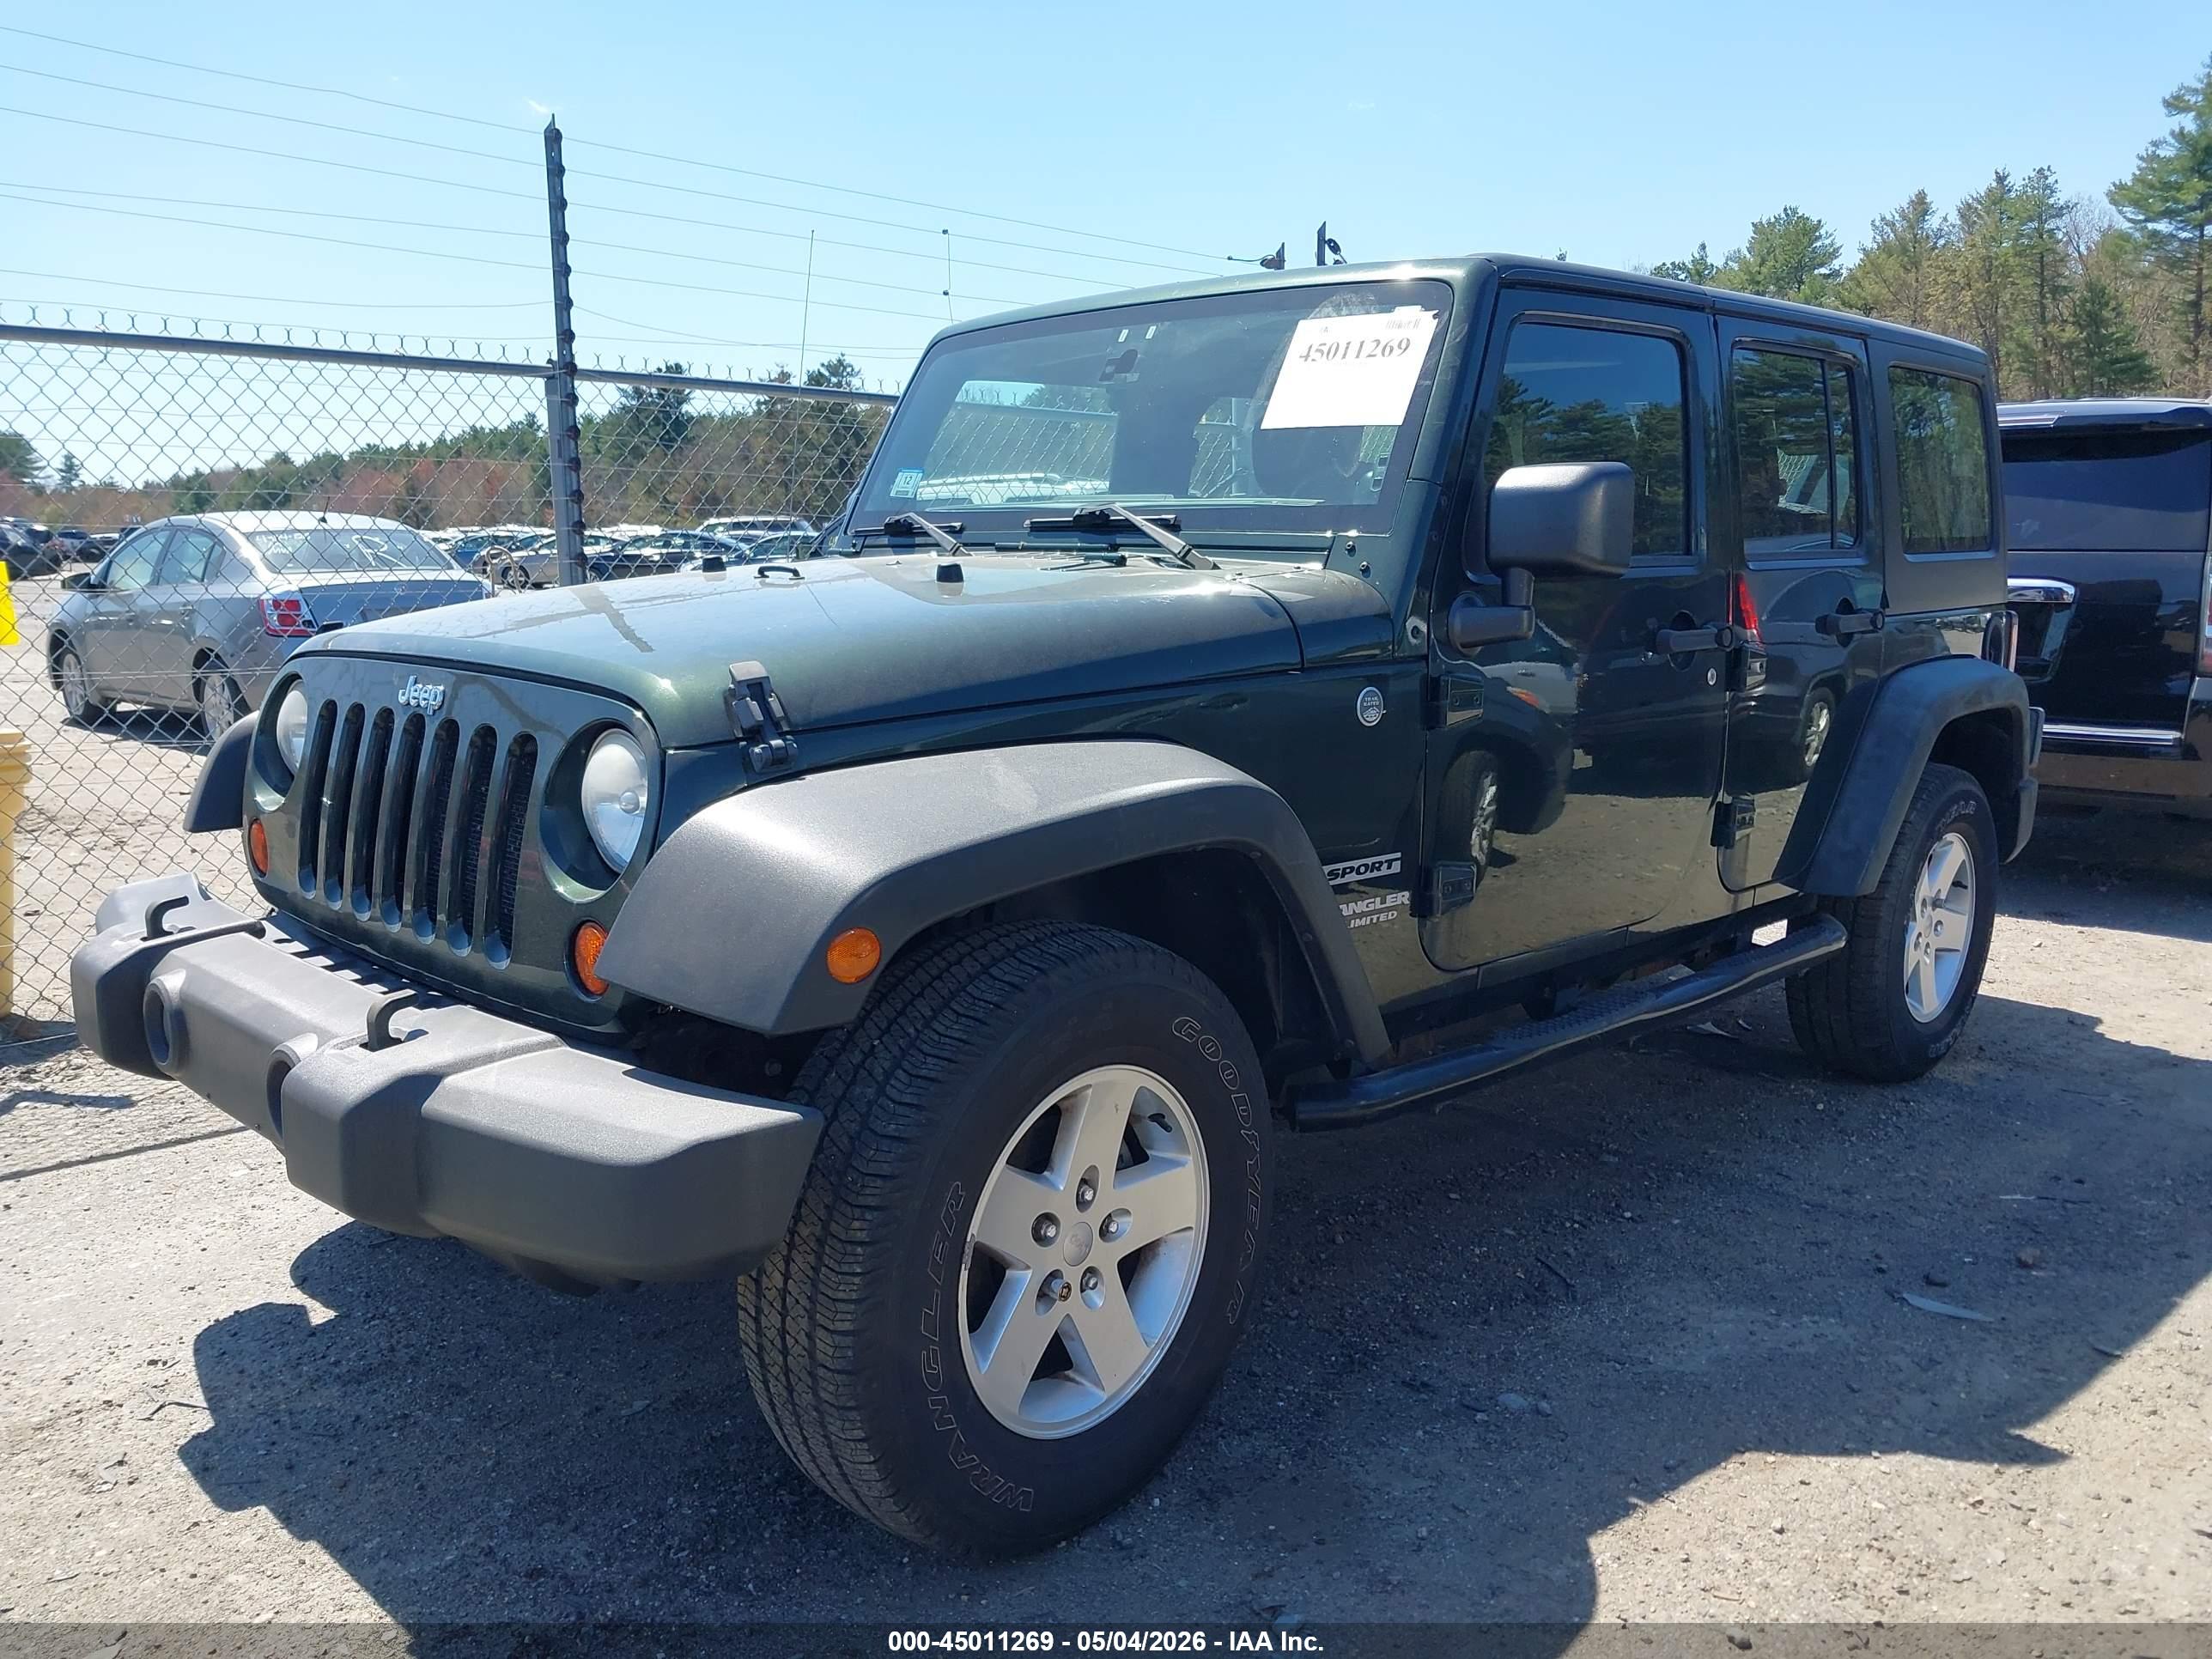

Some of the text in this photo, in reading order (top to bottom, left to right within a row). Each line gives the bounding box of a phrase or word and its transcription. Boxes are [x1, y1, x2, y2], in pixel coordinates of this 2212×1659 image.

[1299, 337, 1411, 362] 45011269
[398, 675, 444, 715] Jeep
[1327, 859, 1400, 881] SPORT
[1347, 911, 1397, 928] IMITED
[1171, 1016, 1261, 1325] GOODYEAR
[921, 1181, 1035, 1512] WRANGLER
